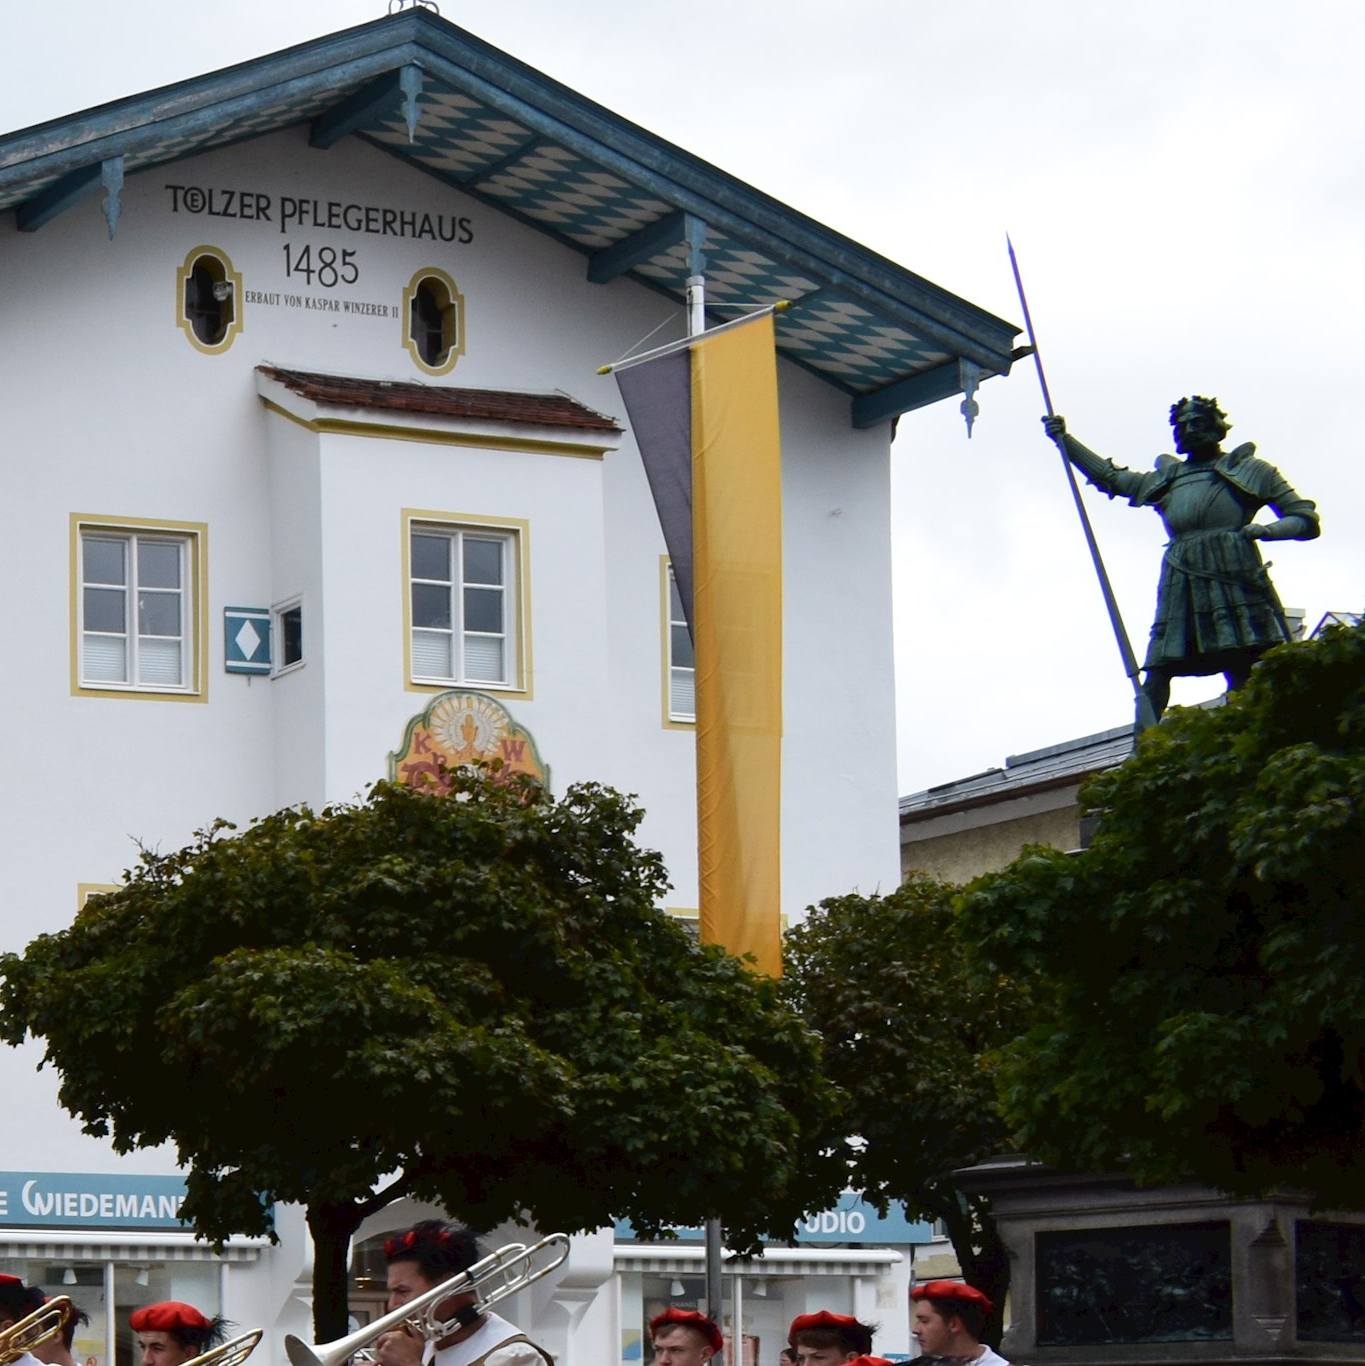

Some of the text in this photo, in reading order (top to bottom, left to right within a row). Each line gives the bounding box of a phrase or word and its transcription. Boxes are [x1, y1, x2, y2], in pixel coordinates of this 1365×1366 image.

[280, 196, 474, 244] PFLEGERHAUS
[283, 243, 359, 288] 1485
[245, 291, 281, 306] ERBAUT
[284, 295, 302, 308] VON
[305, 297, 340, 312] KASPAR
[343, 301, 389, 318] WINZERER
[793, 1209, 866, 1235] UDIO
